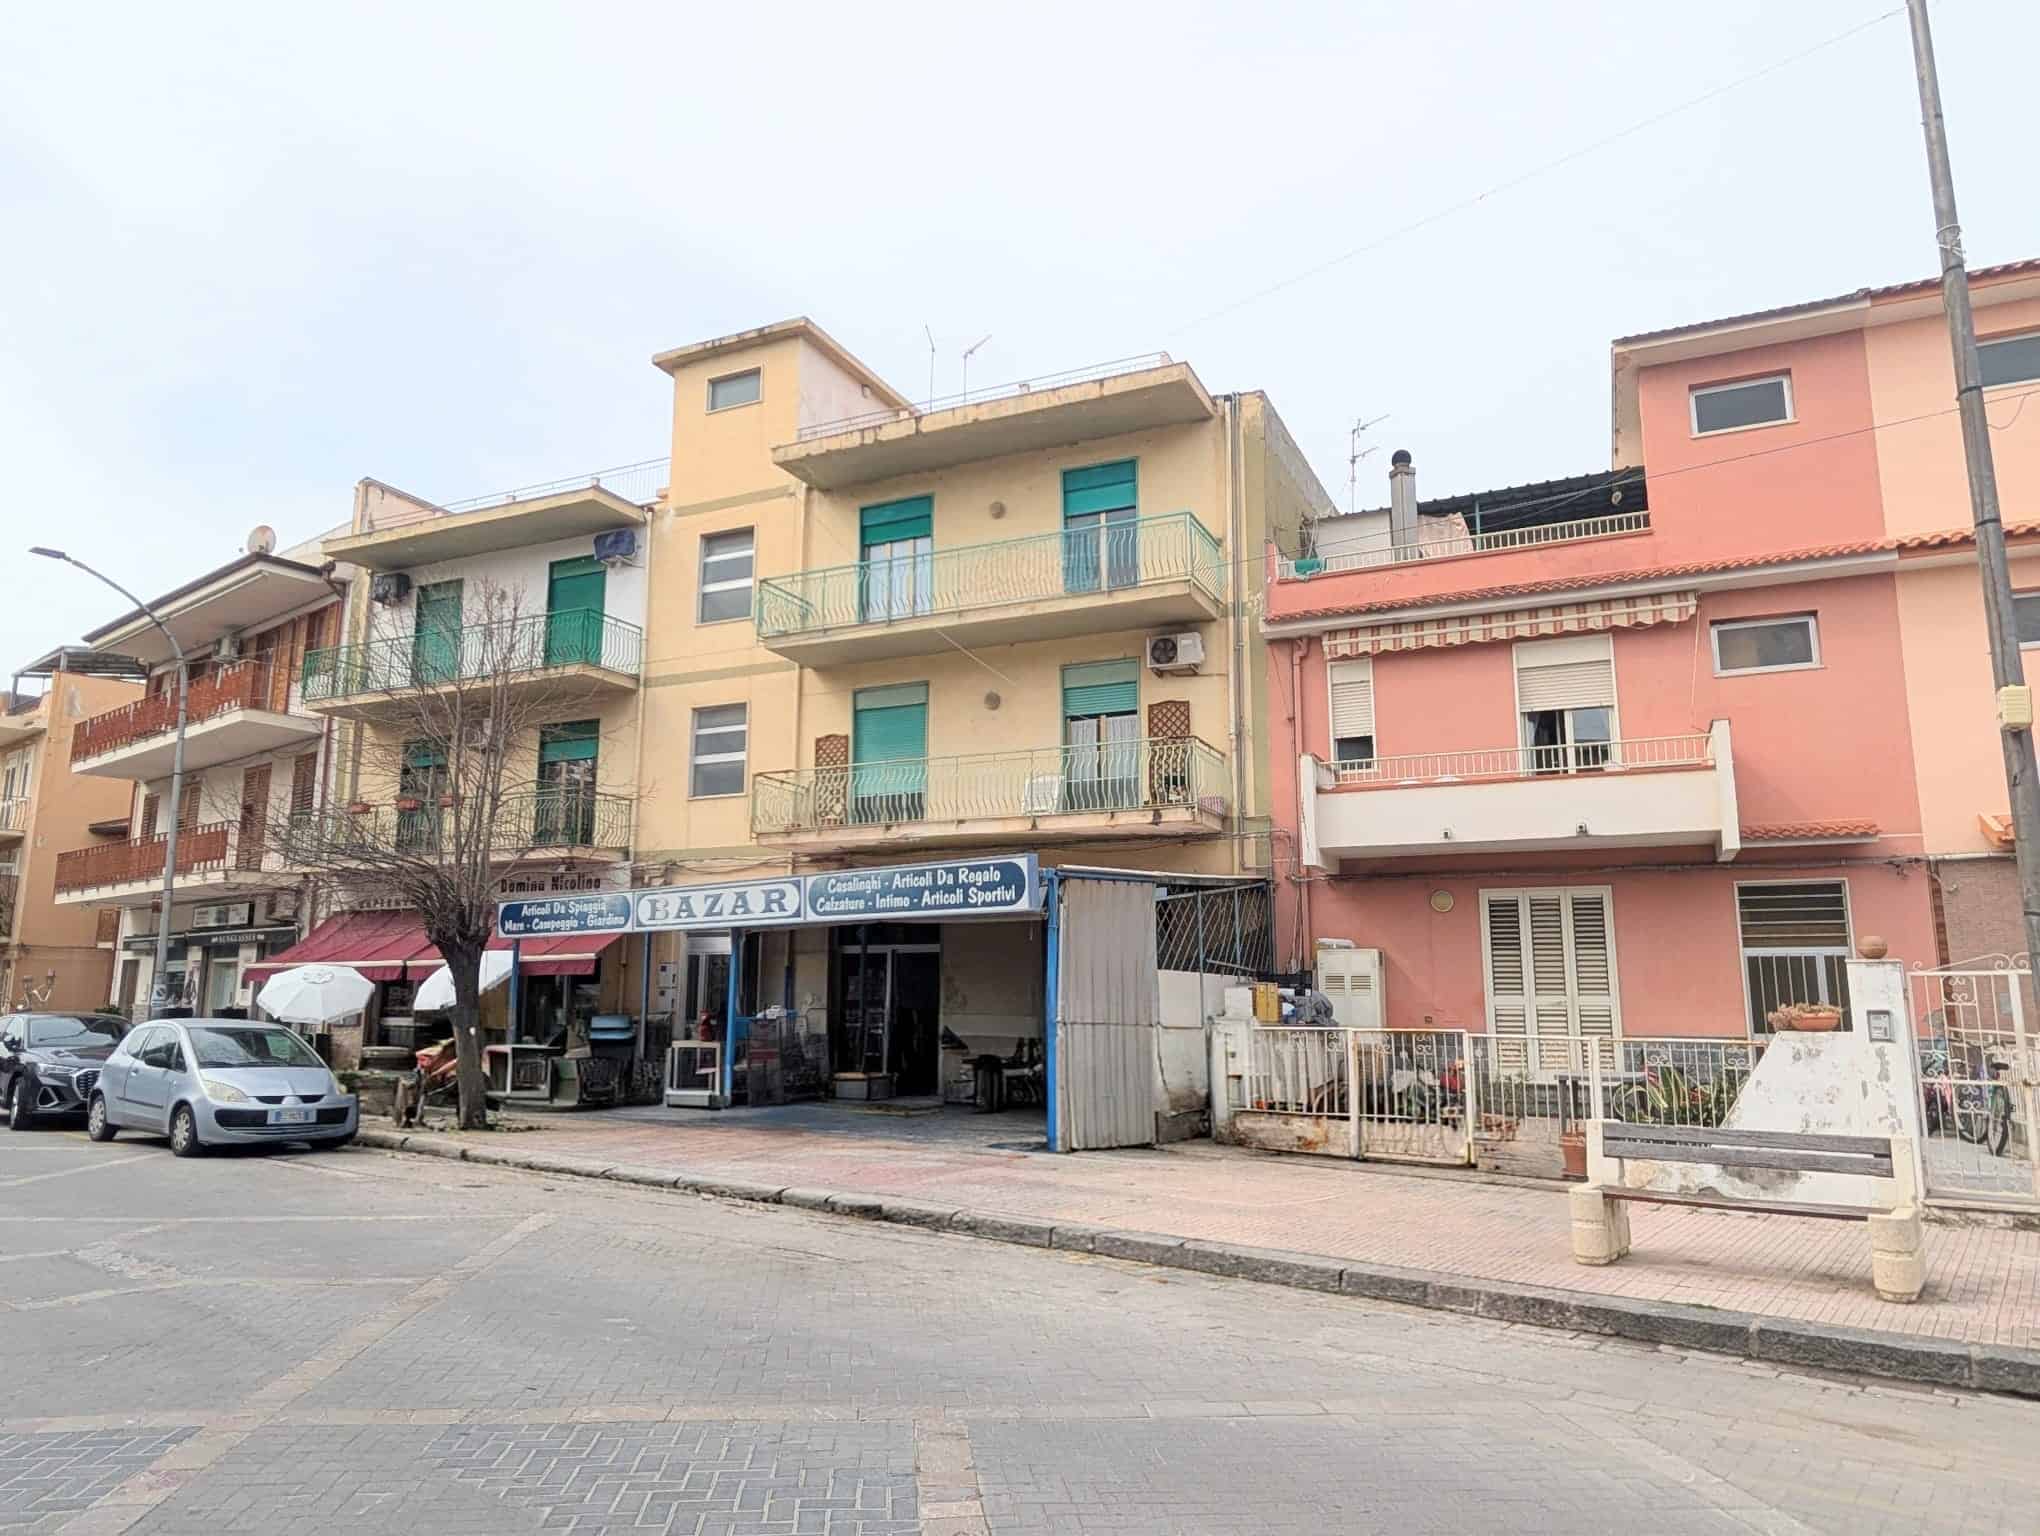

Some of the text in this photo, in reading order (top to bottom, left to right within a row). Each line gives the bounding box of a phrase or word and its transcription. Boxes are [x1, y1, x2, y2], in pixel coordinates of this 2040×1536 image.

[893, 870, 933, 889] Articoli
[937, 868, 954, 886] Da
[959, 865, 1001, 886] Regalo
[648, 888, 788, 921] BAZAR
[876, 893, 910, 909] Intimo
[921, 887, 964, 907] Articoli
[968, 884, 1016, 906] Sportivi
[521, 903, 551, 917] Articoli
[553, 902, 566, 914] Da
[505, 919, 525, 932] Mare
[532, 917, 578, 931] Campeggio
[587, 913, 625, 927] Giardino
